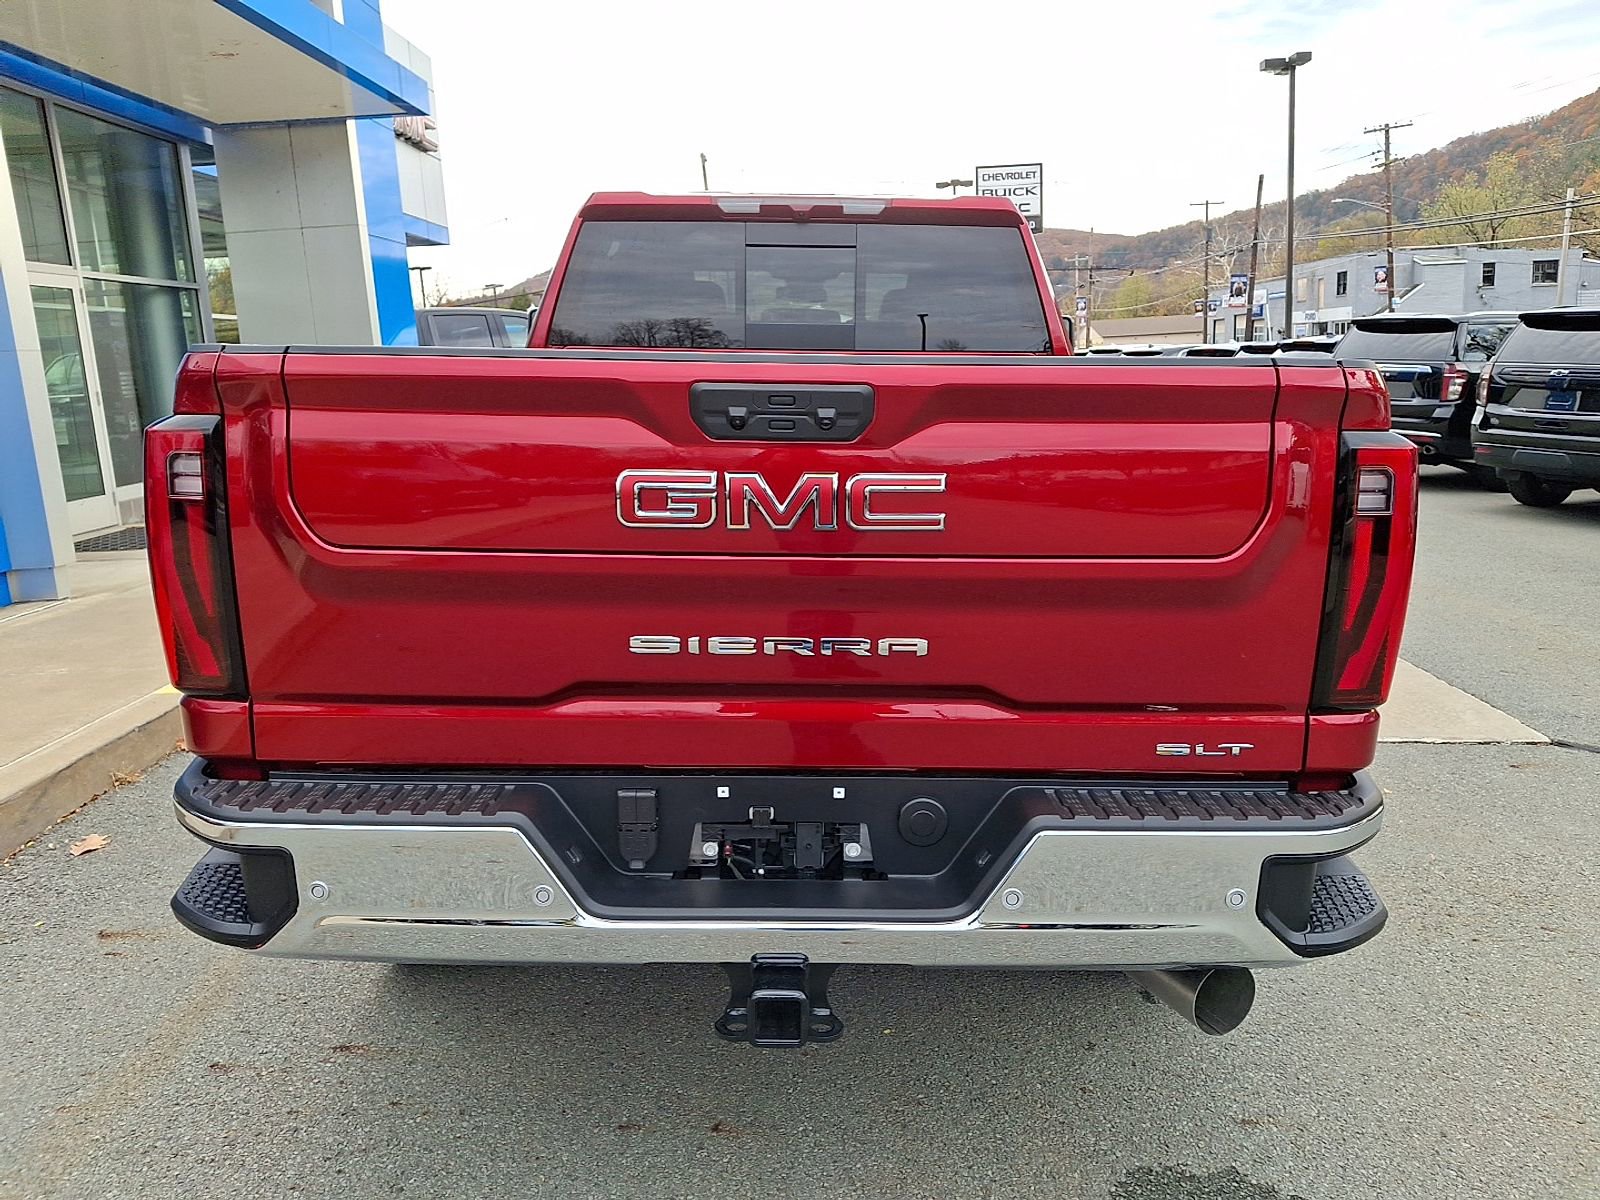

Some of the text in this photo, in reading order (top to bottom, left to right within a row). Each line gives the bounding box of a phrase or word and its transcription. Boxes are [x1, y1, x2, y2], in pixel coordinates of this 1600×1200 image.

[394, 116, 438, 152] MC
[982, 171, 1037, 182] CHEVROLET
[982, 186, 1038, 196] BUICK
[615, 469, 947, 531] GMC
[629, 635, 929, 657] SIERRA
[1155, 743, 1255, 756] SLT
